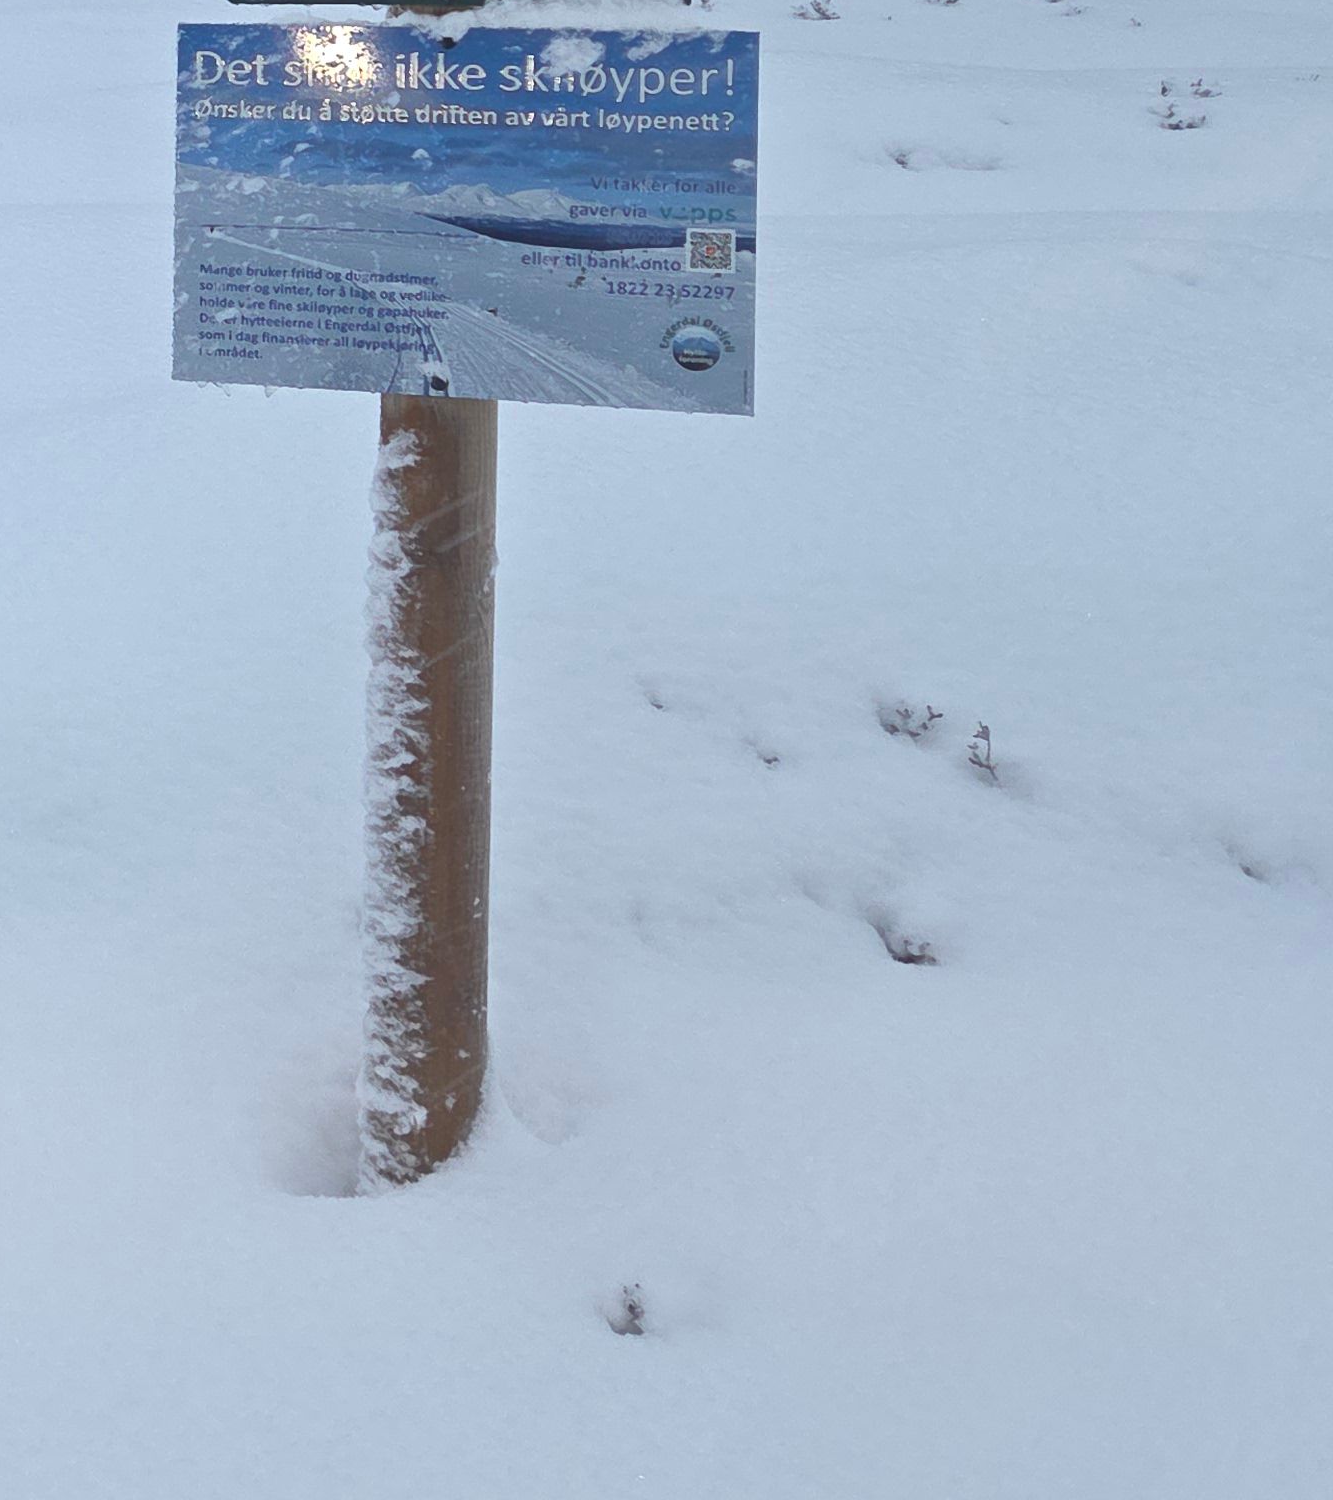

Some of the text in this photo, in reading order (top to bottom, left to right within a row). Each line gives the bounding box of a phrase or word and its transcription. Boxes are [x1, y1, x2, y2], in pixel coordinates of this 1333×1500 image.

[195, 50, 269, 86] Det
[395, 51, 487, 91] ikke
[195, 97, 735, 133] Ønsker du å støtte driften av vårt løypenett?
[591, 177, 608, 190] Vi
[675, 178, 699, 194] for
[705, 180, 737, 195] alle
[569, 205, 617, 219] gaver
[621, 204, 647, 219] via
[521, 251, 560, 267] eller
[565, 252, 582, 267] til
[199, 263, 243, 277] Mange
[246, 265, 287, 278] bruker
[326, 271, 342, 283] og
[254, 284, 270, 296] og
[272, 283, 314, 297] vinter,
[316, 284, 335, 297] for
[339, 285, 346, 298] å
[350, 287, 376, 301] lage
[380, 290, 396, 303] og
[607, 281, 735, 301] 1822 23 52297
[199, 296, 235, 309] holde
[268, 298, 293, 312] fine
[296, 301, 355, 316] skiløyper
[358, 306, 374, 318] og
[378, 305, 450, 320] gapahuker.
[241, 313, 314, 329] hytteeierne
[325, 318, 381, 333] Engerdal
[659, 316, 701, 350] Engerdal
[198, 330, 225, 340] som
[235, 331, 259, 345] dag
[261, 332, 330, 347] finansierer
[333, 336, 349, 348] all
